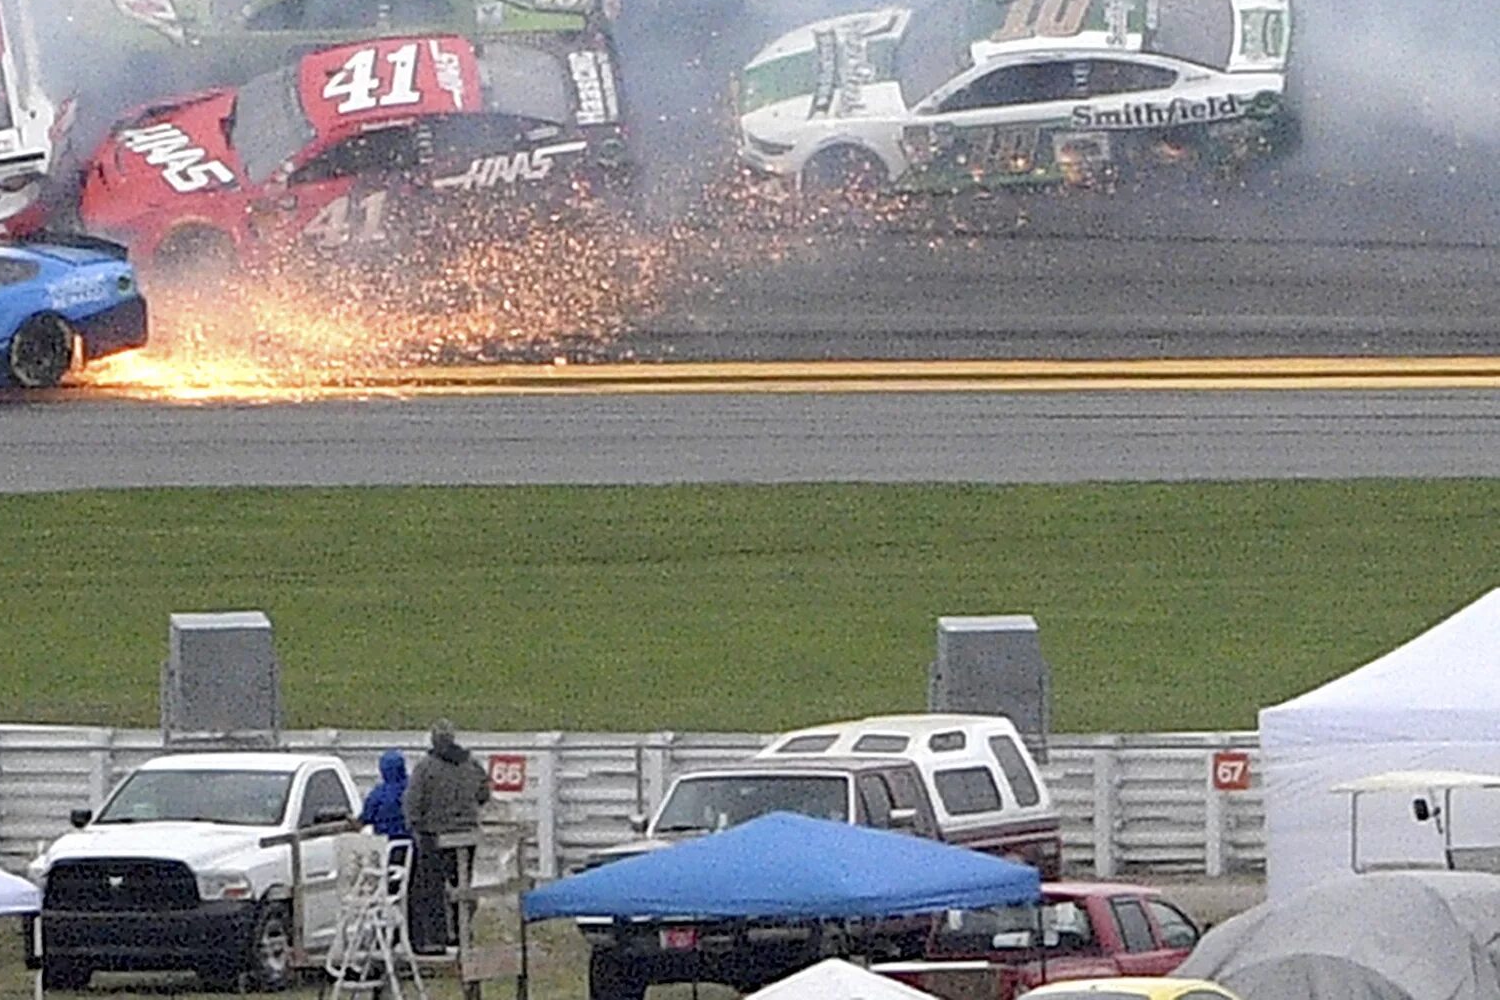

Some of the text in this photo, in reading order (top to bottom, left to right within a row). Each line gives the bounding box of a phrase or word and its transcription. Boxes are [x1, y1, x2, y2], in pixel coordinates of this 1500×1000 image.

[322, 43, 423, 114] 41
[1071, 92, 1237, 128] Smithfield
[120, 122, 236, 193] HAAS
[432, 140, 588, 190] HAAS
[302, 190, 387, 258] 41
[492, 762, 522, 785] 66
[1217, 760, 1245, 783] 67
